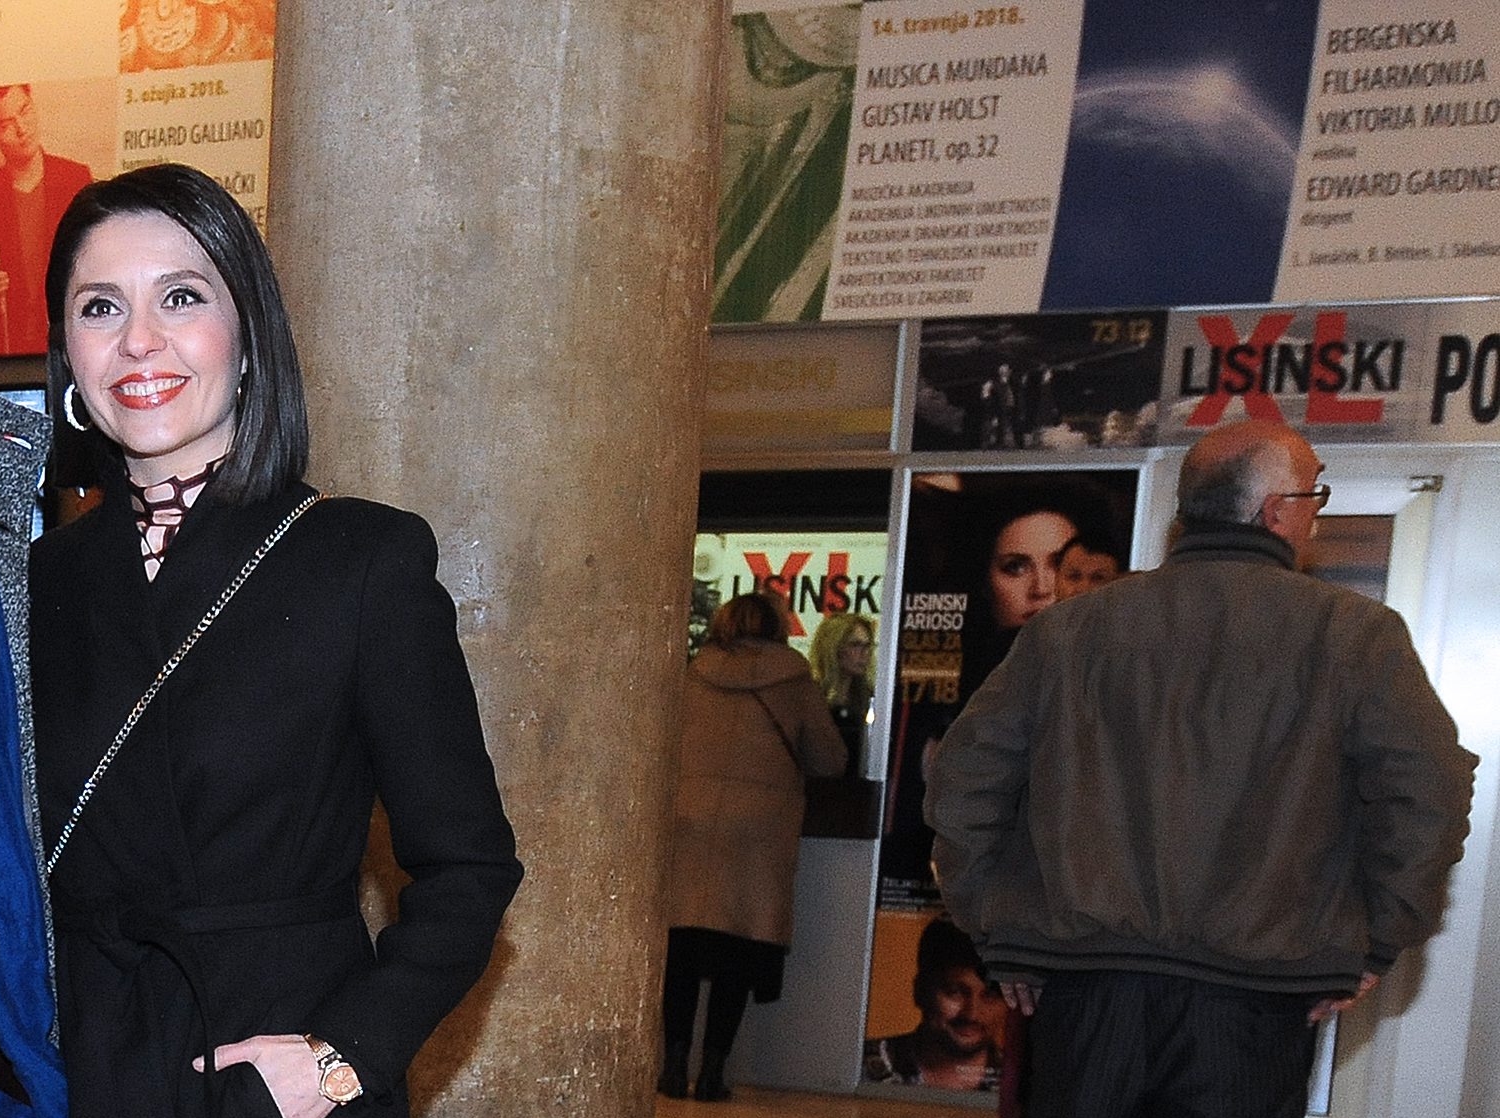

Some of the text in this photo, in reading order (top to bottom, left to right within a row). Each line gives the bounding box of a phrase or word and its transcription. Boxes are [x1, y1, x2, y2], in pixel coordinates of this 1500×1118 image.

[873, 7, 1025, 37] 14. travnja 2018.
[1326, 20, 1457, 55] BERGENSKA
[866, 53, 1048, 90] MUSICA MUNDANA
[1321, 58, 1489, 95] FILHARMONIJA
[125, 88, 139, 104] 3.
[189, 79, 230, 99] 2018.
[862, 94, 1001, 128] GUSTAV HOLST
[123, 118, 265, 151] RICHARD GALLIANO
[857, 133, 1000, 166] PLANETI, op.32
[1306, 163, 1500, 203] EDWARD GARDNE
[1179, 339, 1406, 397] LISINSKI
[1184, 311, 1385, 428] XL
[904, 592, 970, 611] LISINSKI
[903, 611, 964, 631] ARIOSO
